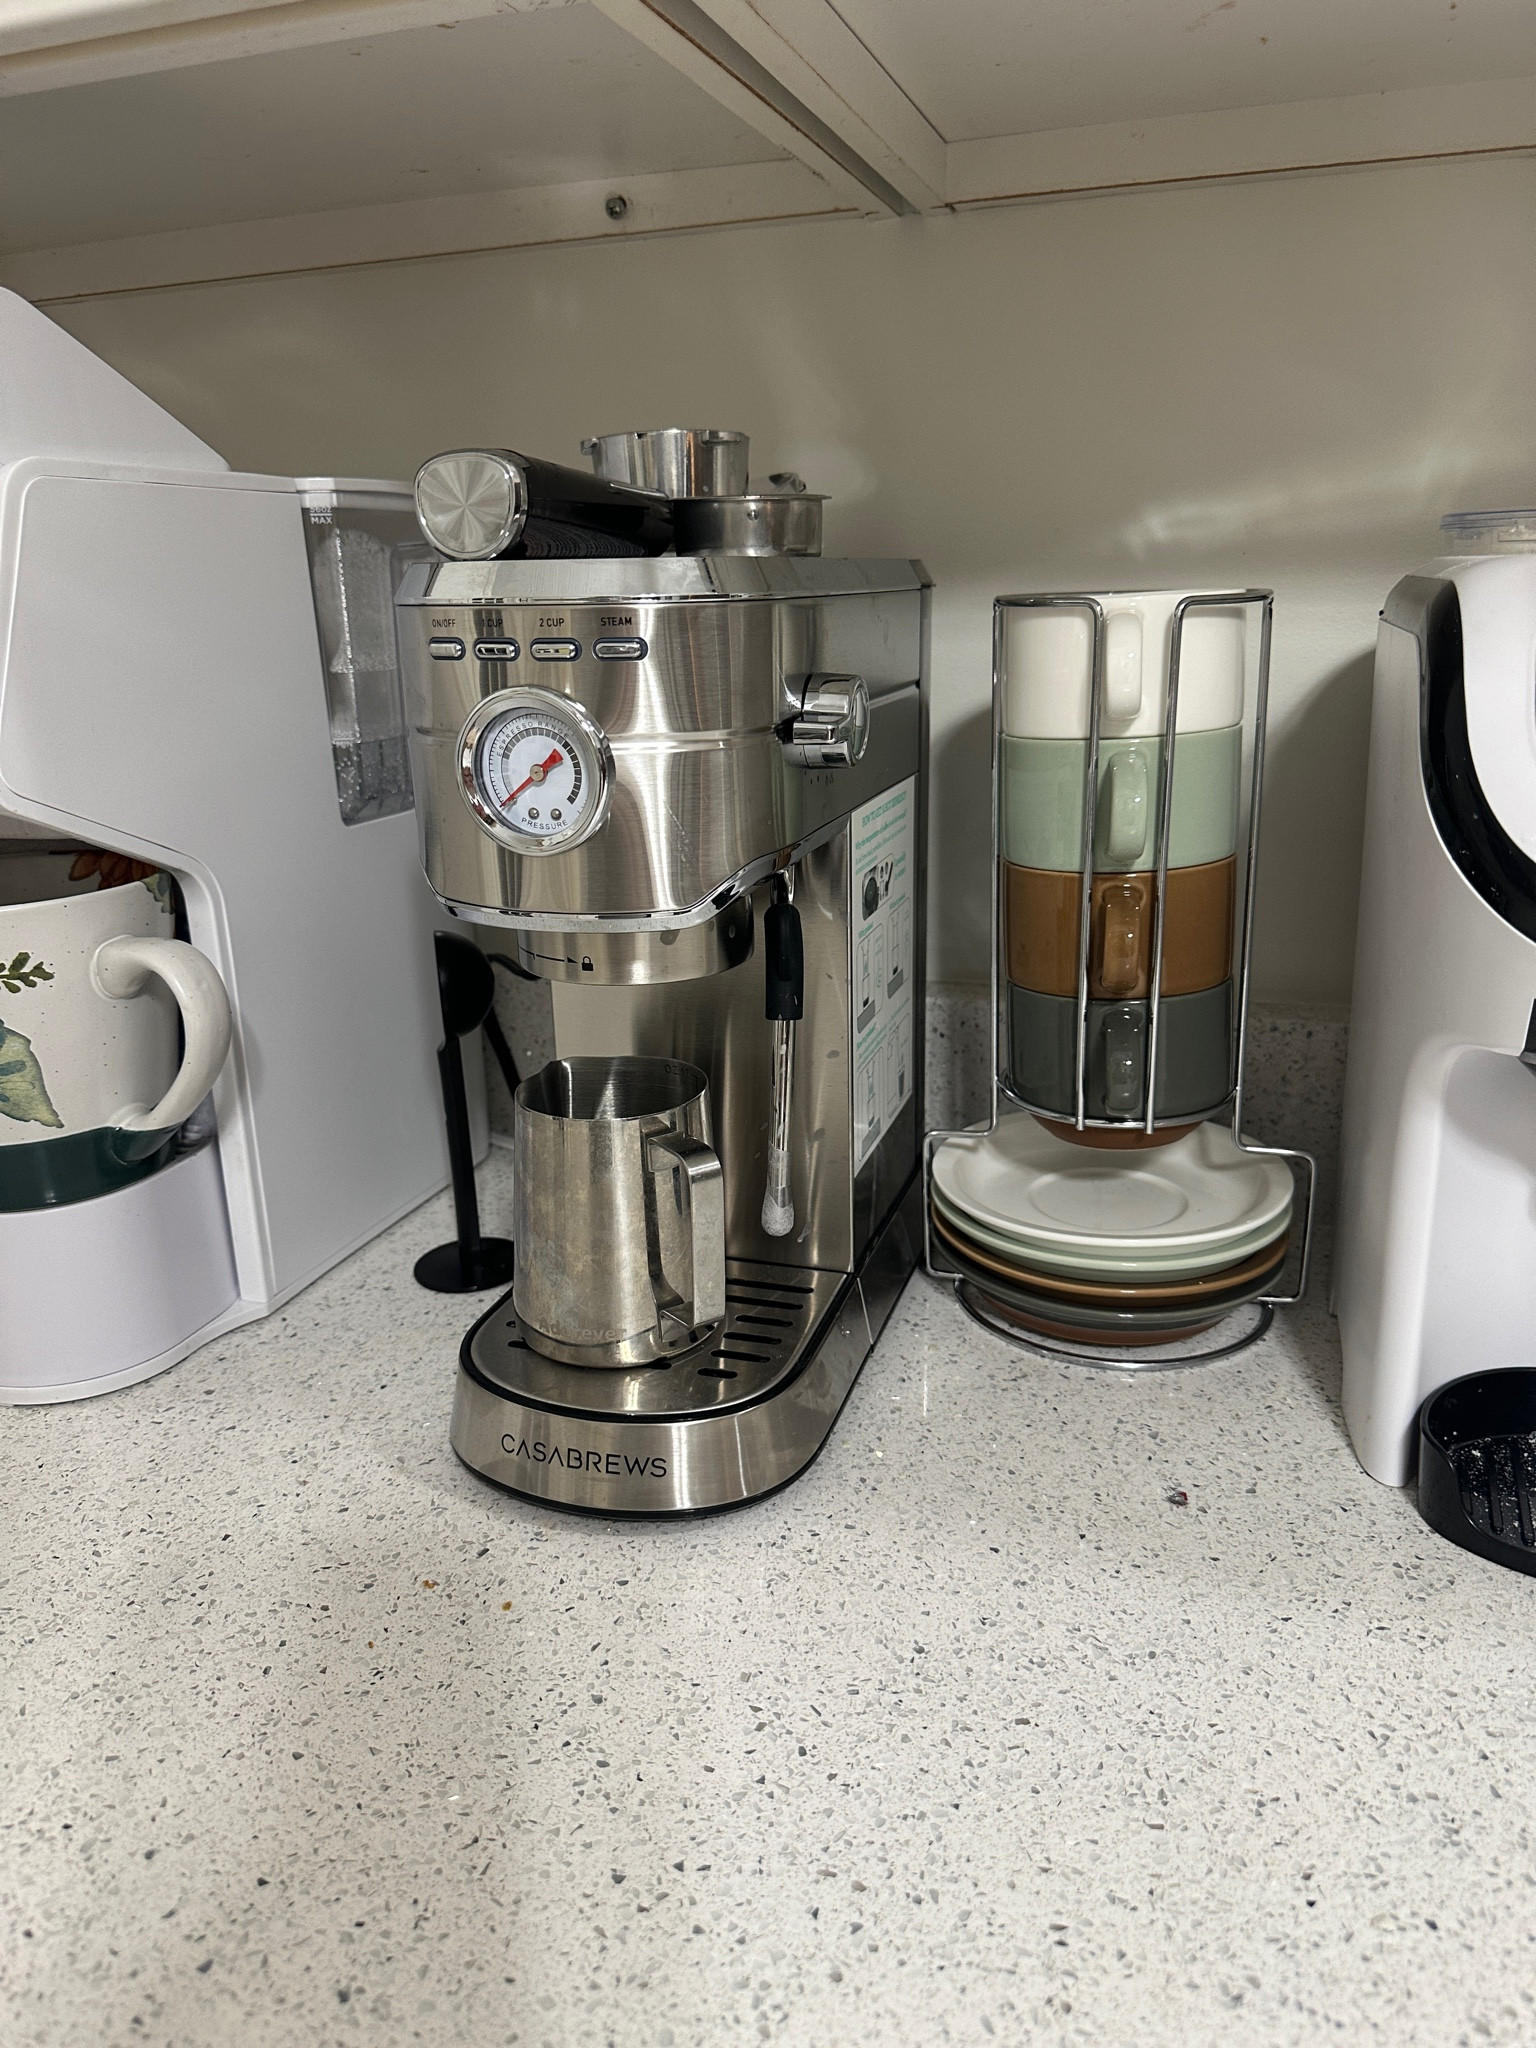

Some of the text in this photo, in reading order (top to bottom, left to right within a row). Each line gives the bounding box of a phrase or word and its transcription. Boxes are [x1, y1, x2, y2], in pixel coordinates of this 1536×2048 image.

[311, 516, 333, 525] MAX
[431, 618, 456, 628] ON/OFF
[487, 618, 503, 628] CUP
[539, 617, 565, 628] 2 CUP
[600, 616, 632, 627] STEAM
[496, 721, 571, 757] ESPRESSO RANGE
[521, 816, 568, 830] PRESSURE
[501, 1433, 668, 1478] CASABREWS
